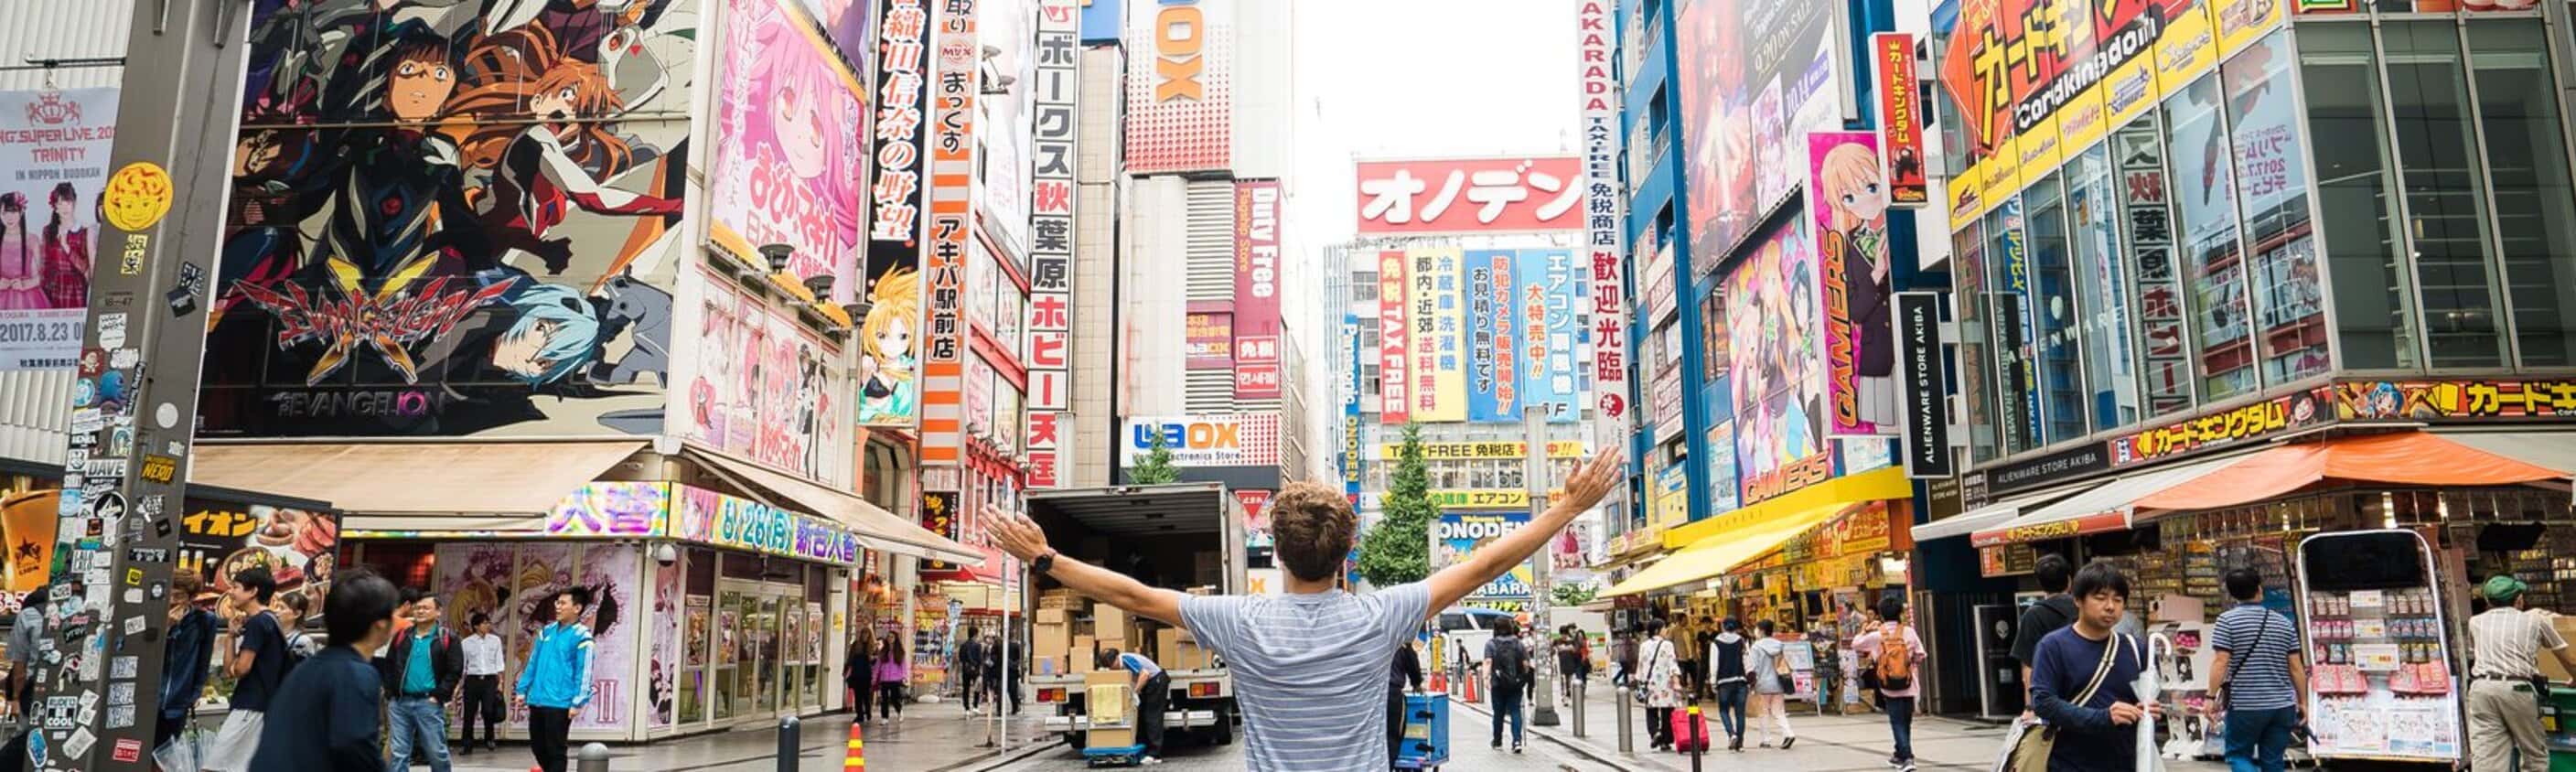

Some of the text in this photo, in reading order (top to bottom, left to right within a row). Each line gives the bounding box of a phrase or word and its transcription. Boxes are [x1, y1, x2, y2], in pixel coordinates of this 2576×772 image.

[1155, 0, 1204, 102] OX
[875, 9, 925, 240] 織田信奈の野望
[30, 146, 86, 165] TRINITY
[1360, 158, 1584, 225] オノデン
[1250, 187, 1278, 298] Duty Free
[932, 219, 961, 359] アキバ駅前店
[1593, 251, 1623, 382] 歓迎光臨
[1822, 224, 1859, 428] GAMERS
[1383, 308, 1406, 418] TAX FREE
[1913, 306, 1936, 464] ALIENWARE STORE AKIBA
[290, 391, 445, 415] EVANGELION
[2155, 401, 2286, 454] カードキングダム
[1428, 445, 1472, 456] FREE
[1476, 445, 1515, 456] 免税店
[1744, 453, 1831, 506] GAMERS
[2041, 460, 2067, 475] STORE
[2069, 452, 2097, 468] AKIBA
[183, 510, 259, 537] イオン
[1474, 493, 1522, 505] エアコン
